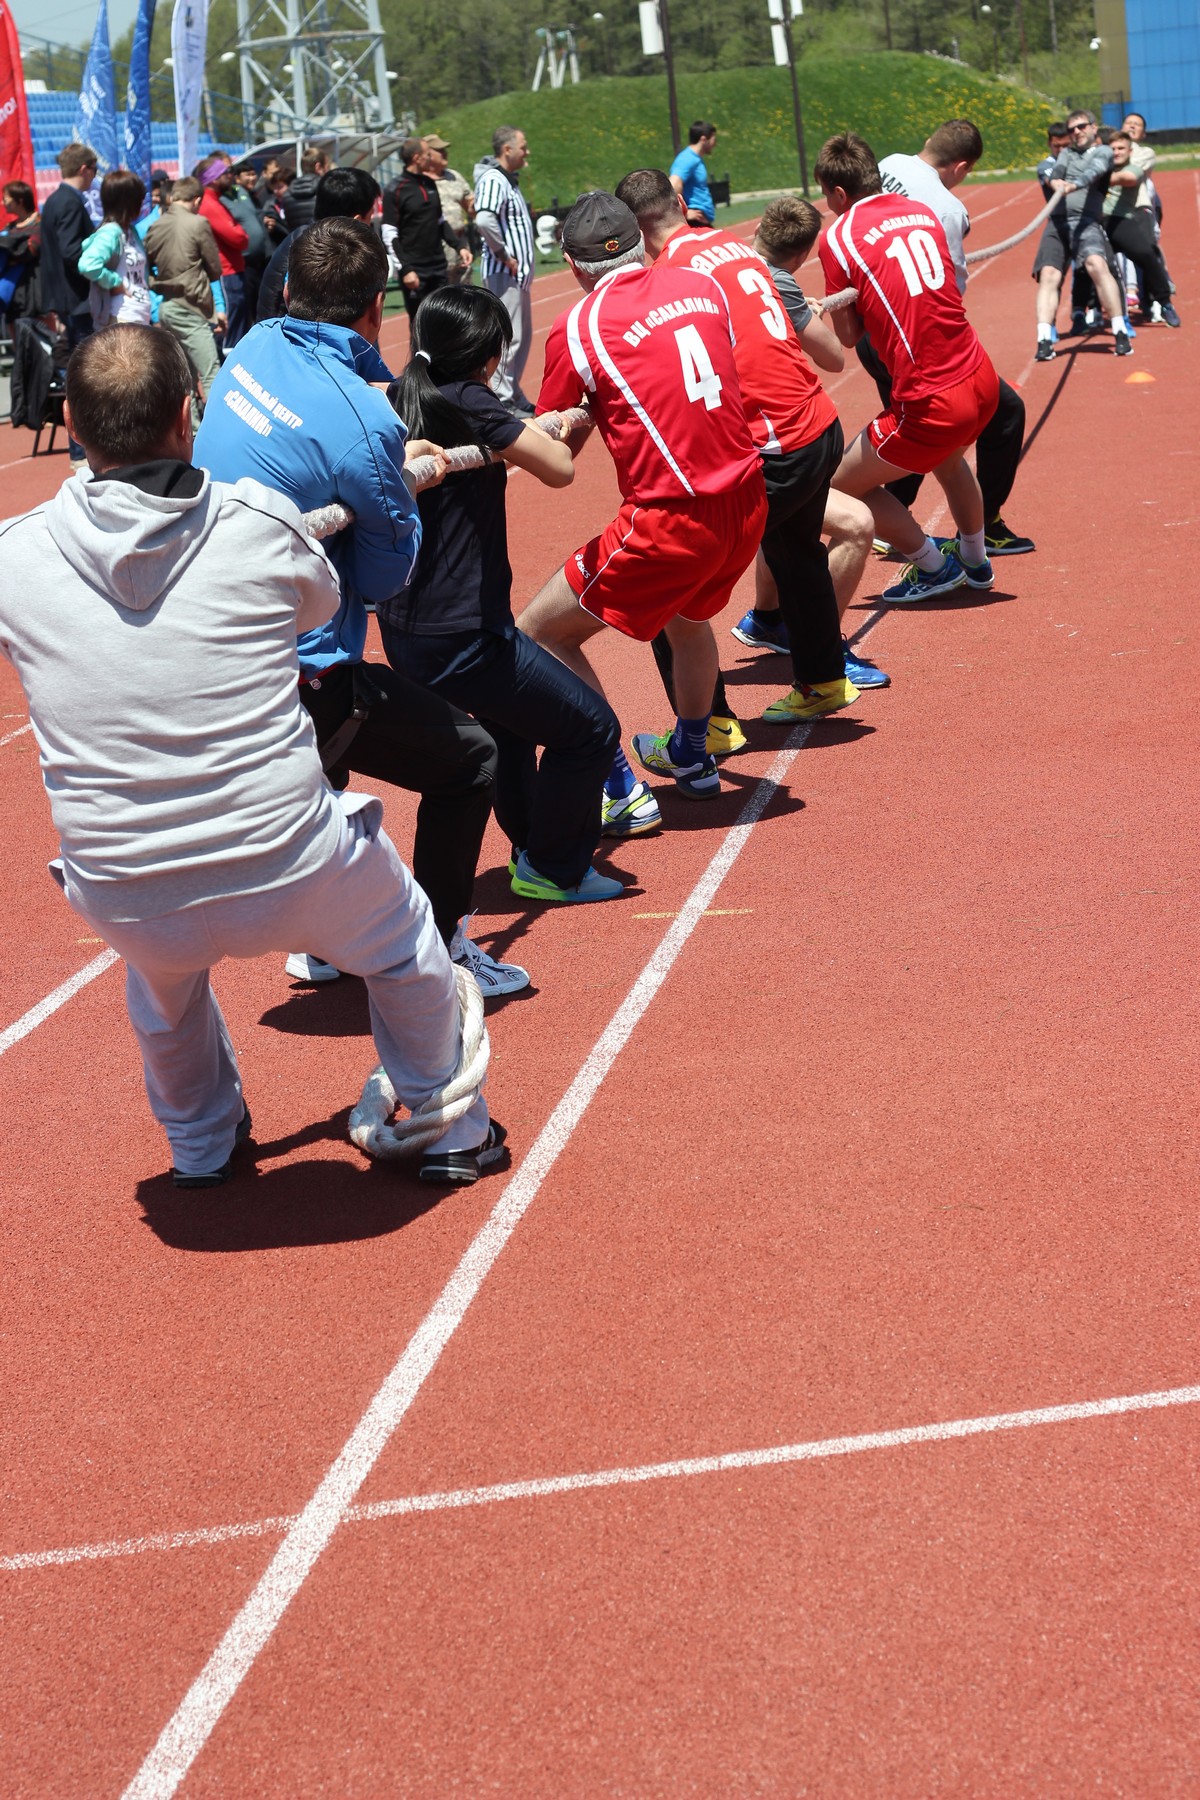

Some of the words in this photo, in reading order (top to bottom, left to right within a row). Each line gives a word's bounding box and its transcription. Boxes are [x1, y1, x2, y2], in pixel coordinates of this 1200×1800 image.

[862, 227, 884, 246] ВЦ
[885, 229, 946, 297] 10
[622, 315, 652, 348] ВЦ
[645, 296, 720, 329] «САХАЛИН»
[737, 268, 788, 341] 3
[673, 324, 723, 411] 4
[223, 389, 273, 438] «САХАЛИН»
[272, 402, 304, 430] ЦЕНТР
